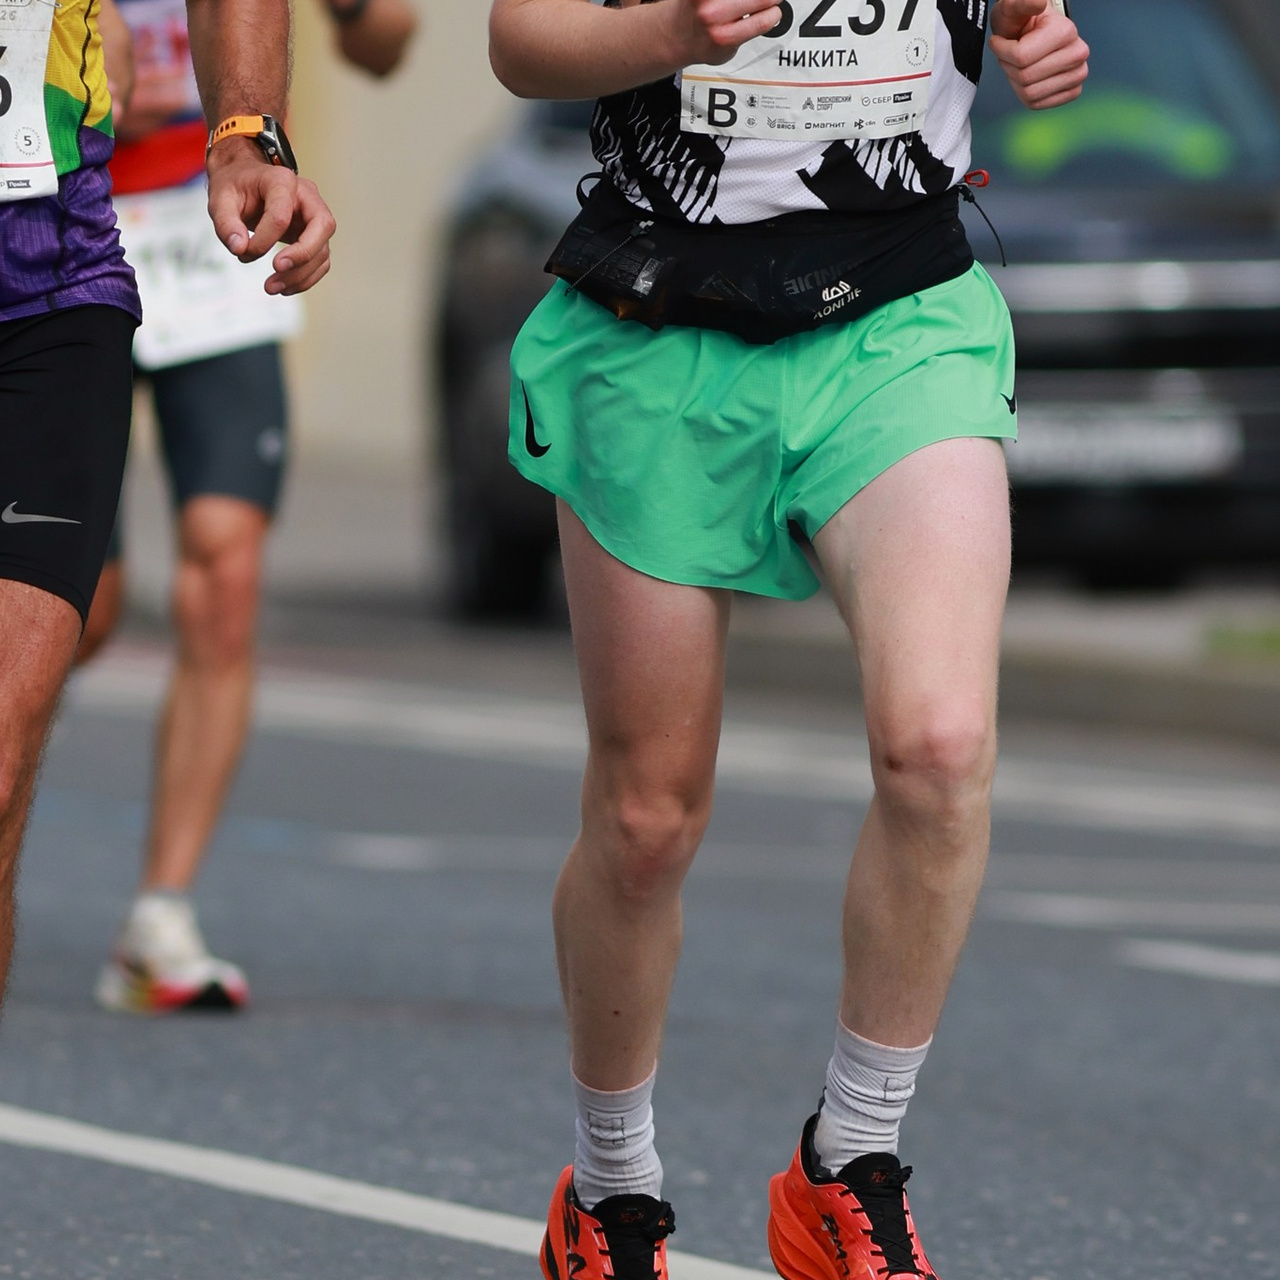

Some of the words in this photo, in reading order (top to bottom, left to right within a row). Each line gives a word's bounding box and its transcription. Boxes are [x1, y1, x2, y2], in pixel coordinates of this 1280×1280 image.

[913, 46, 919, 57] 1
[778, 49, 859, 67] НИКИТА
[872, 96, 892, 104] СБЕР
[23, 135, 32, 146] 5
